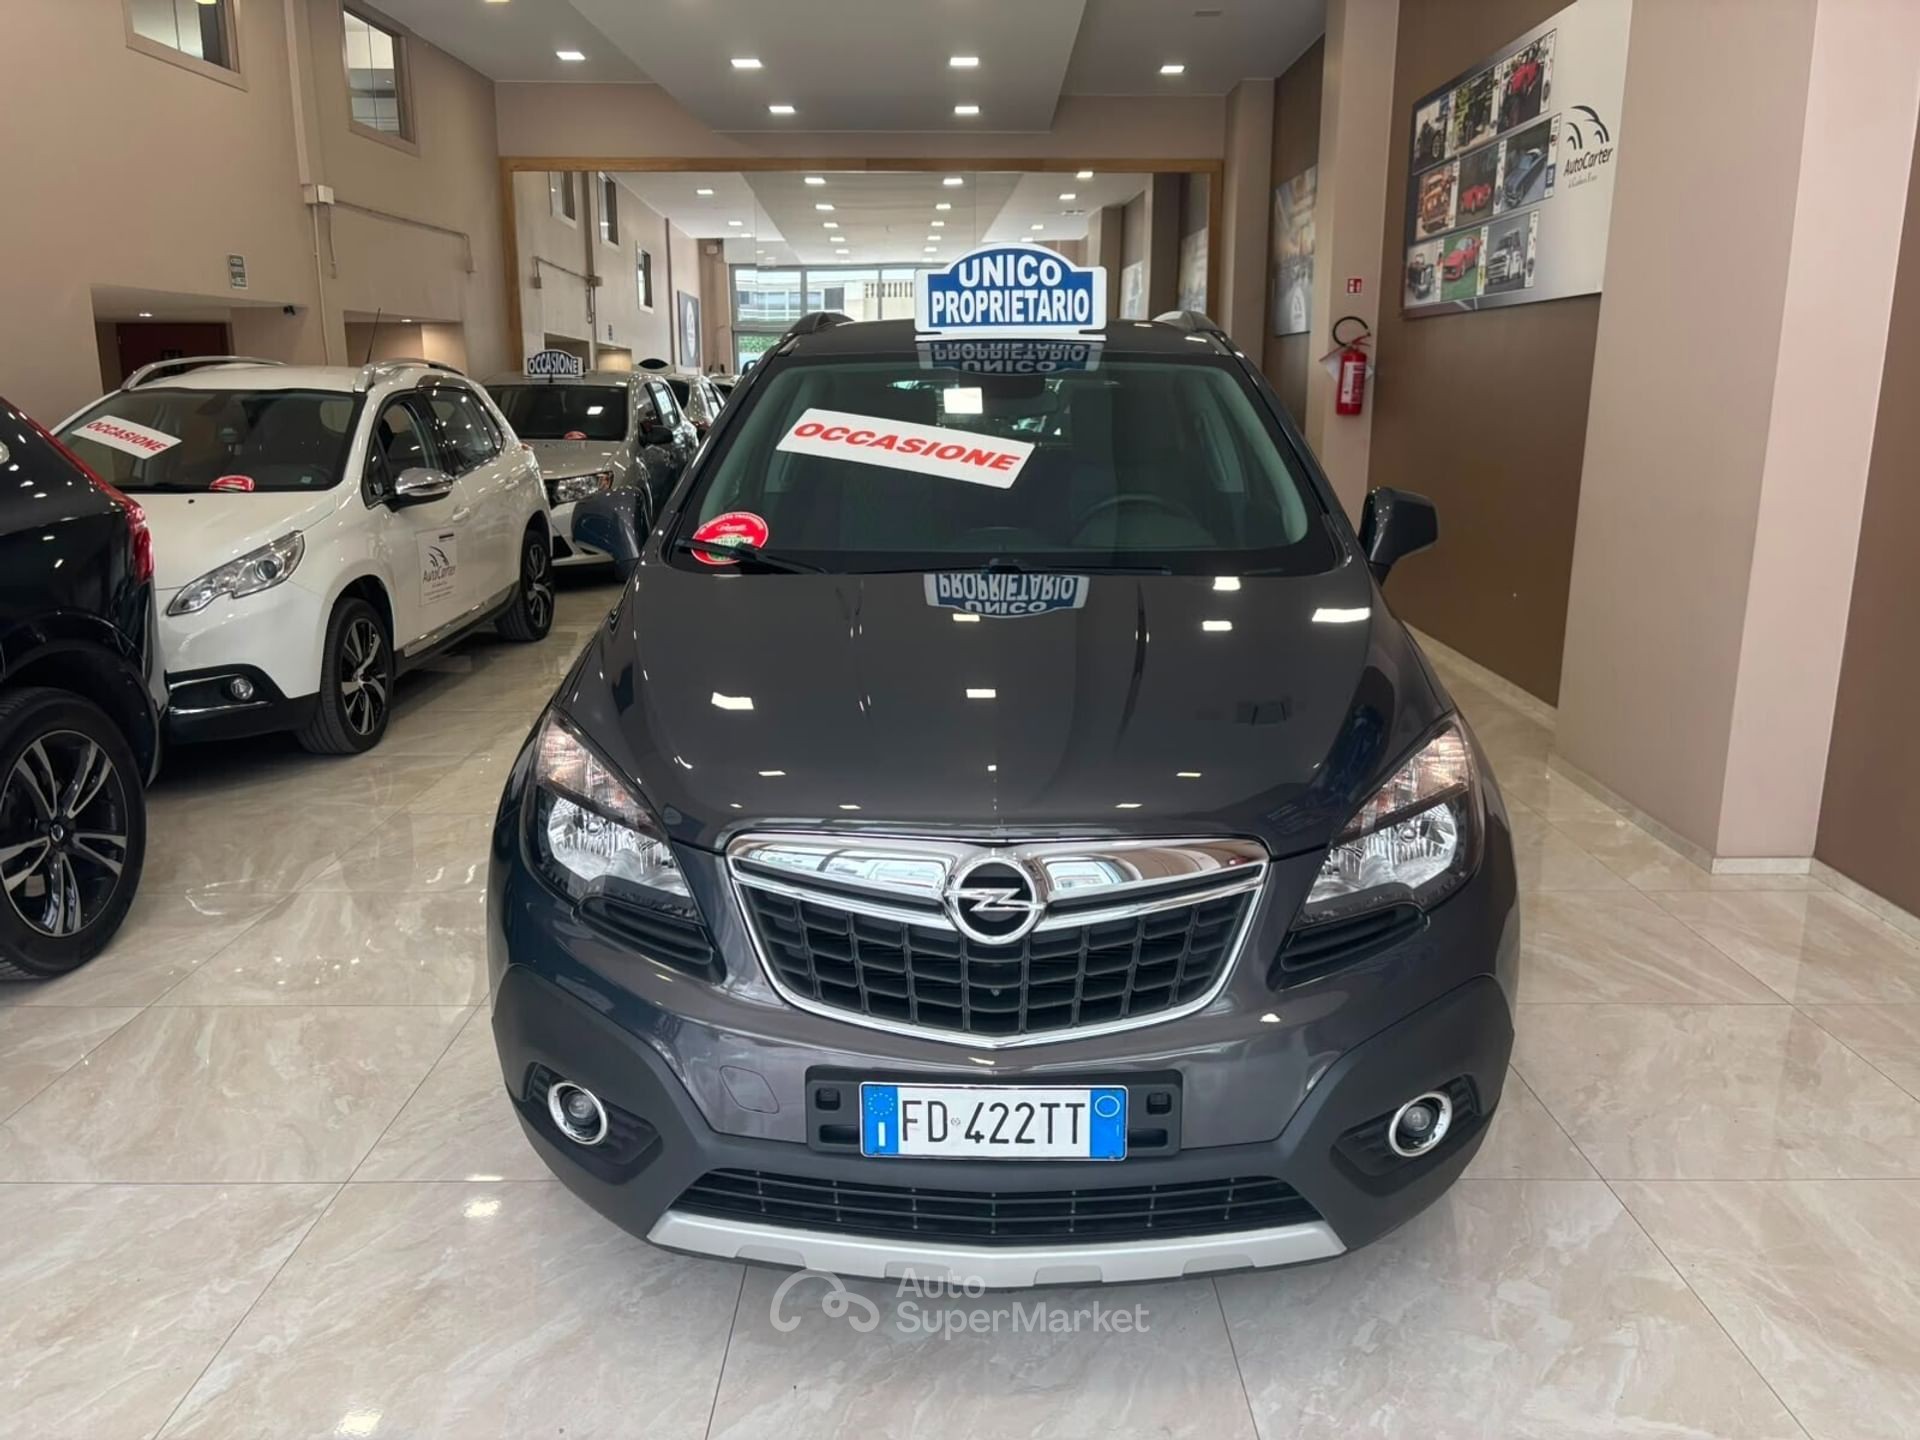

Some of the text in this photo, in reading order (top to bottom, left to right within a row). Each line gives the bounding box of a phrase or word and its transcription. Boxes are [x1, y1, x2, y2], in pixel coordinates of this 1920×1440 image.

[1563, 148, 1613, 176] AutoCarter
[958, 254, 1062, 287] UNICO
[931, 288, 1090, 323] PROPRIETARIO
[528, 352, 578, 373] OCCASIONE
[86, 421, 168, 452] OCCASIONE
[794, 423, 1020, 471] OCCASIONE
[901, 1100, 1086, 1144] FD 422TT
